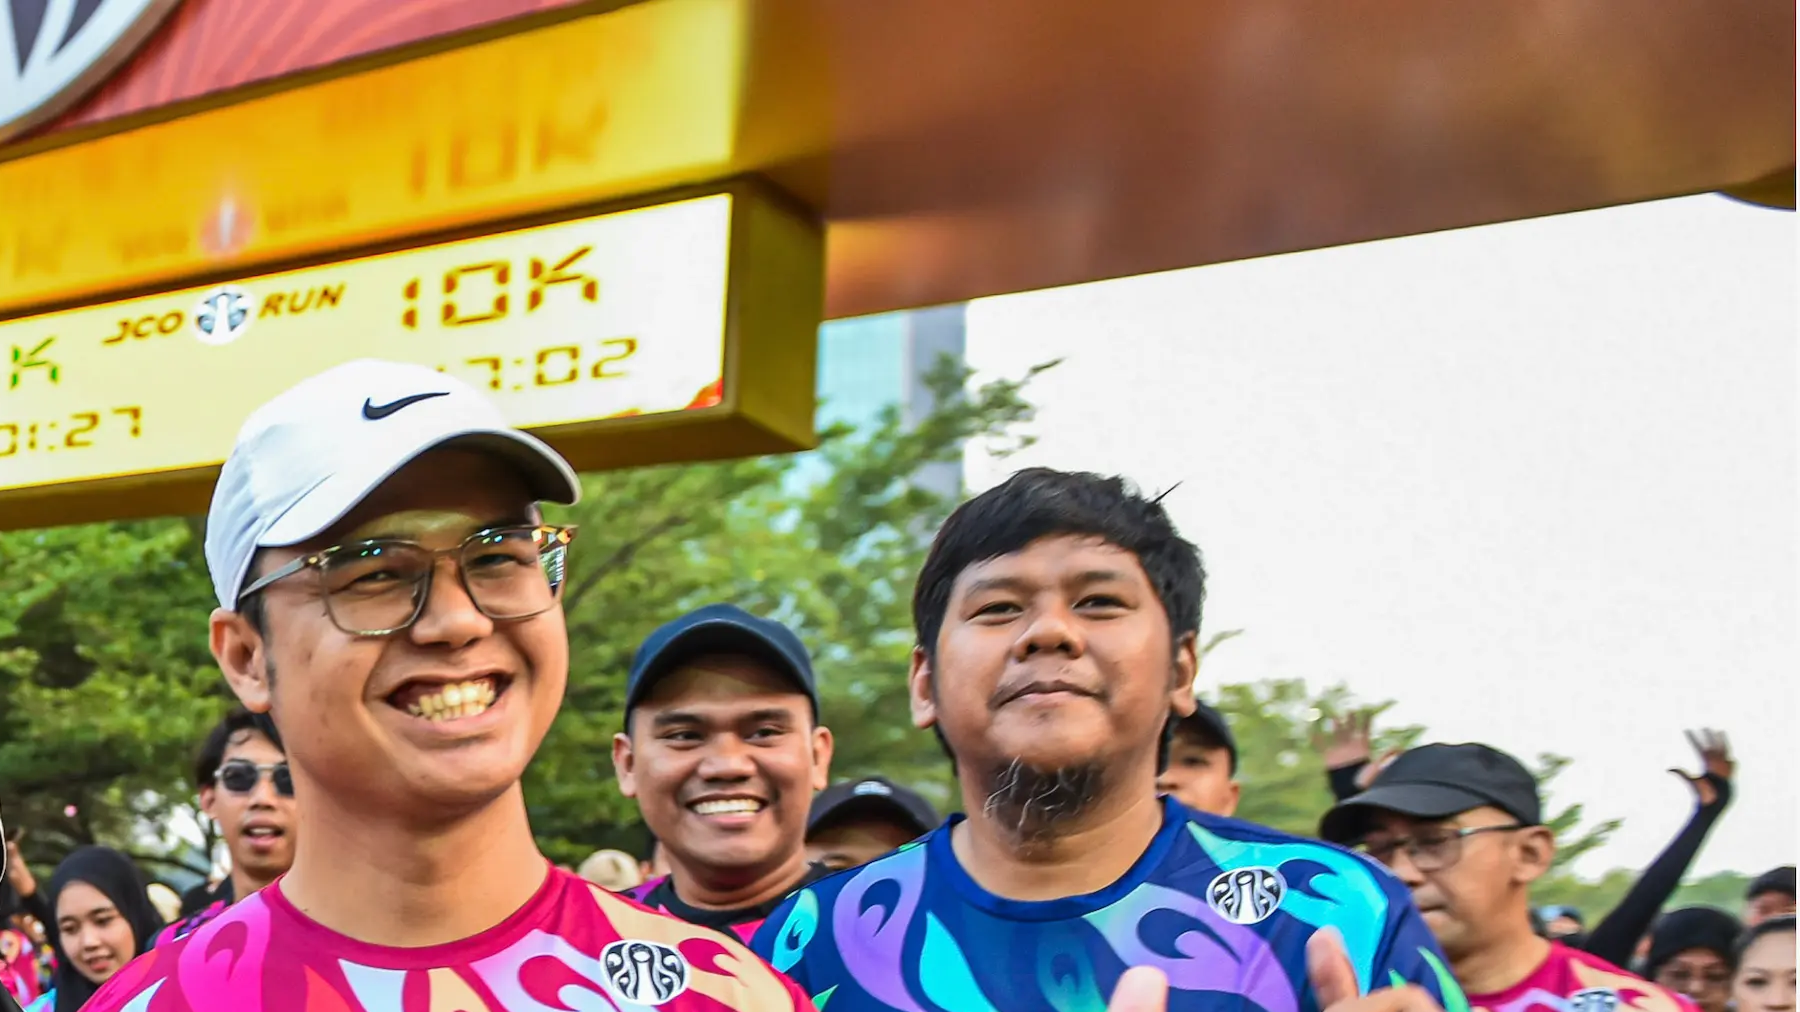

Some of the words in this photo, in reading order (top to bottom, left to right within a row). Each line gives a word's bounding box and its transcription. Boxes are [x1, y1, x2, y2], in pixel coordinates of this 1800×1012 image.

[102, 311, 185, 346] JCO
[258, 283, 346, 320] RUN
[403, 246, 598, 330] 10K
